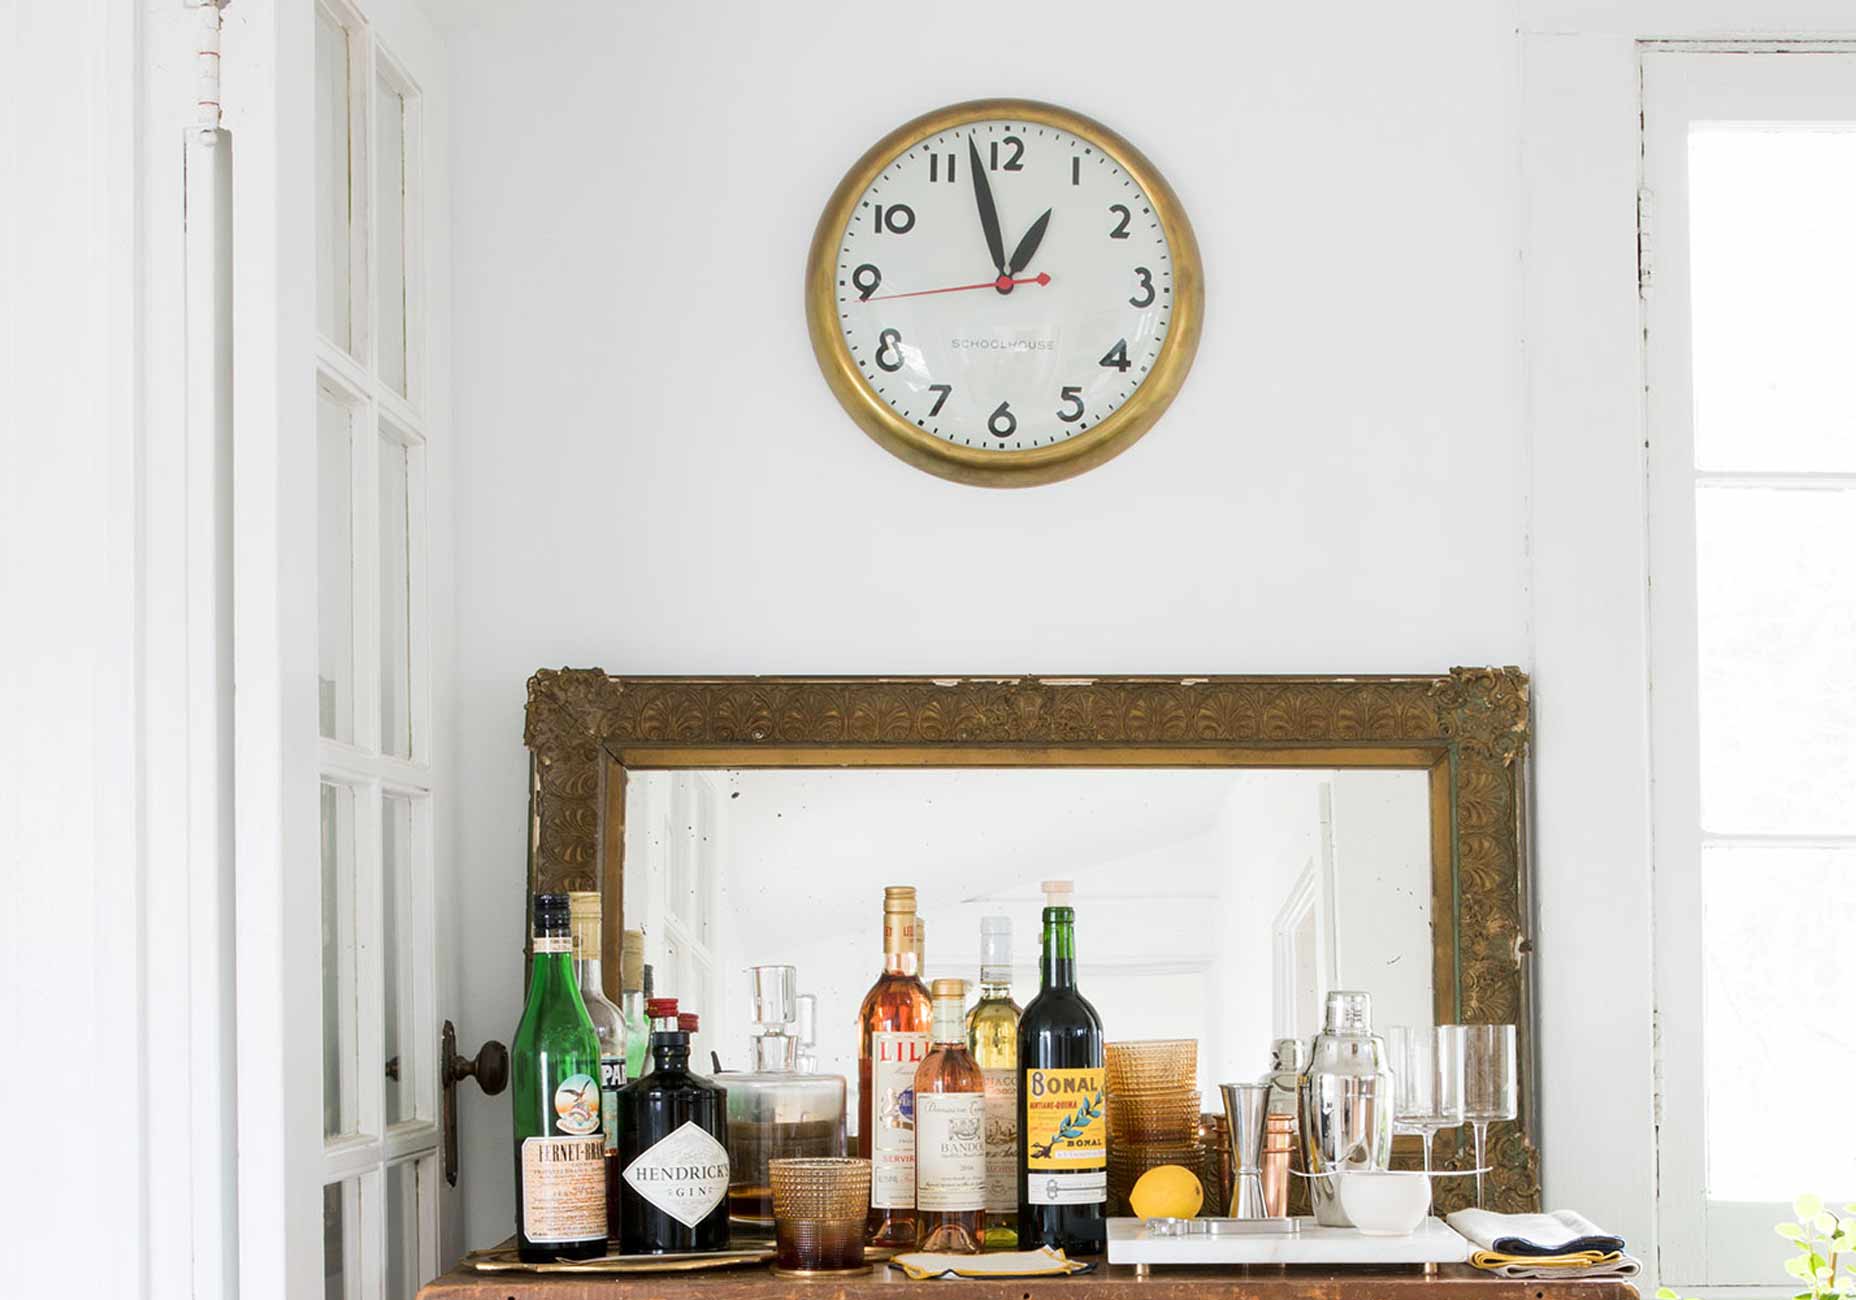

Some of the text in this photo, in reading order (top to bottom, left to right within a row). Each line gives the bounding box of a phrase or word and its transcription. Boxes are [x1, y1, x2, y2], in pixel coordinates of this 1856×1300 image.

[930, 153, 955, 182] 11
[990, 136, 1024, 171] 12
[1072, 156, 1080, 186] 1
[874, 203, 916, 234] 10
[1109, 204, 1131, 239] 2
[852, 263, 882, 302] 9
[1129, 266, 1156, 308] 3
[875, 328, 905, 372] 8
[951, 338, 1055, 351] SCHOOLHOUSE
[1099, 338, 1132, 372] 4
[928, 384, 953, 416] 7
[1056, 386, 1085, 422] 5
[988, 400, 1017, 438] 6
[1032, 1071, 1098, 1096] BONAL
[1066, 1138, 1102, 1147] BONAL
[675, 1187, 707, 1198] GIN
